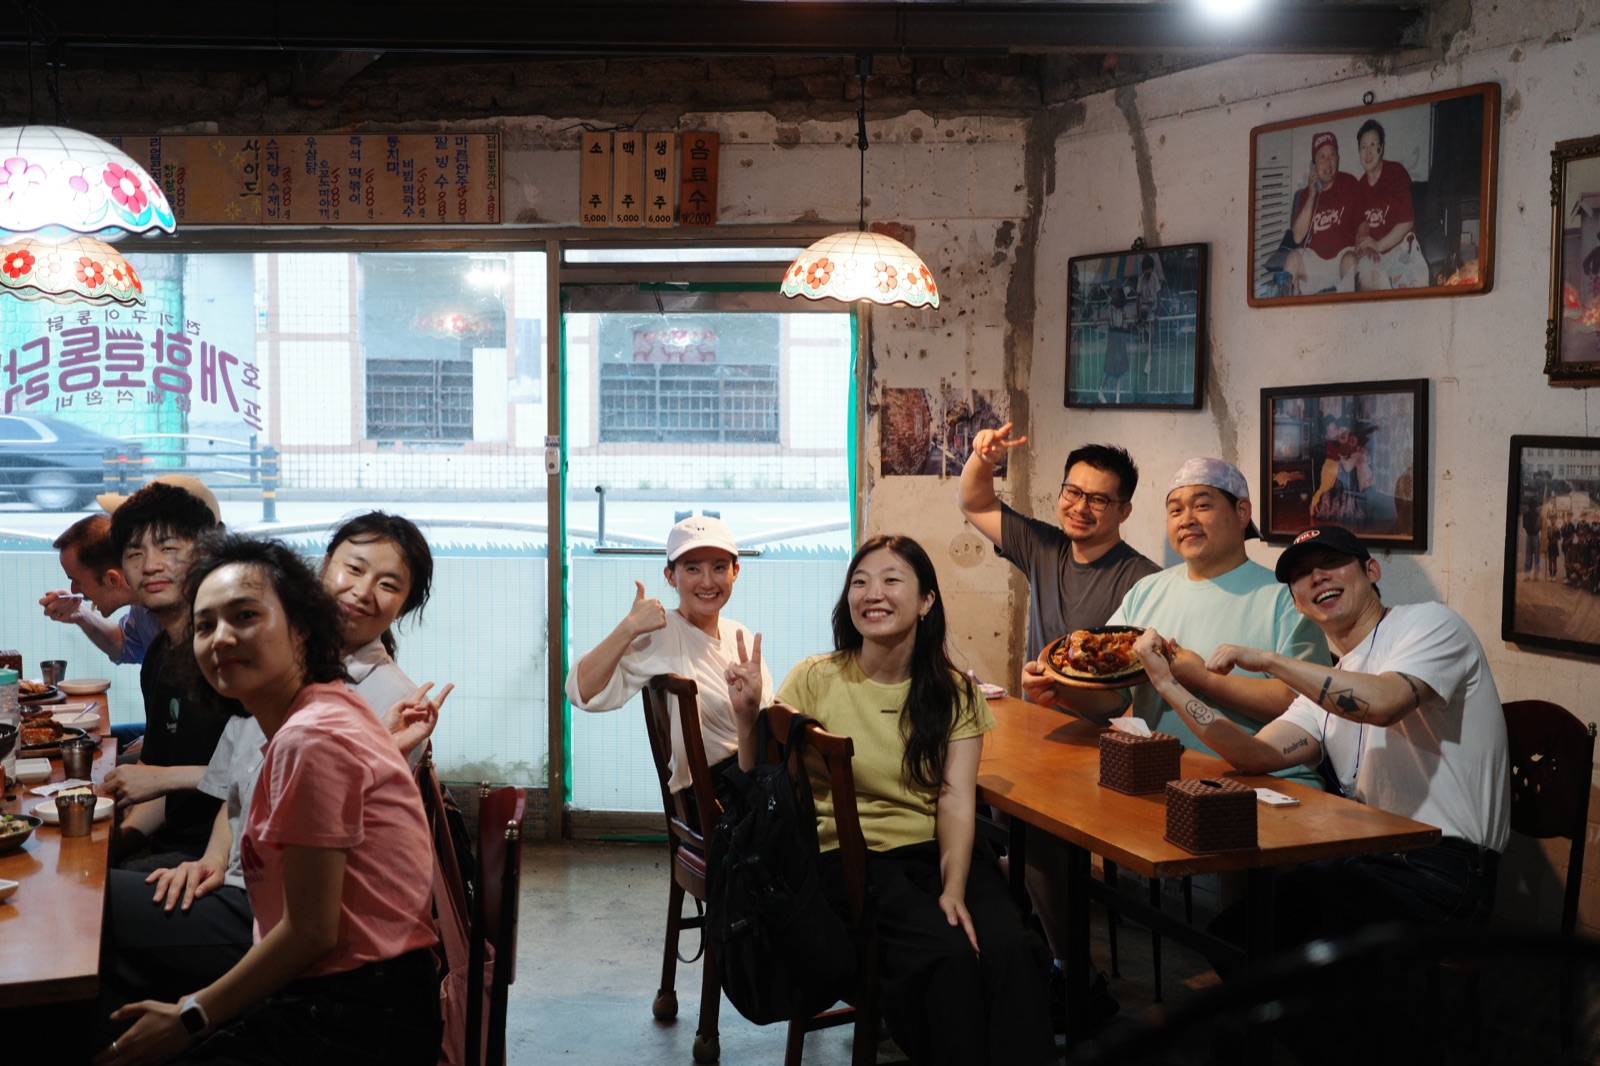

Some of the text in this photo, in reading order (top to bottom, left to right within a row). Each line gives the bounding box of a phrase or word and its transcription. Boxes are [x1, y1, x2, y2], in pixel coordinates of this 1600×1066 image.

[240, 139, 262, 197] 사이드
[386, 136, 401, 176] 동치미
[455, 135, 470, 186] 마른안주
[589, 142, 604, 208] 소주
[621, 140, 635, 208] 맥주
[653, 140, 667, 209] 생맥주
[688, 139, 710, 210] 음료수
[584, 214, 607, 223] 5,000
[617, 214, 639, 223] 5,000
[648, 215, 671, 223] 6,000
